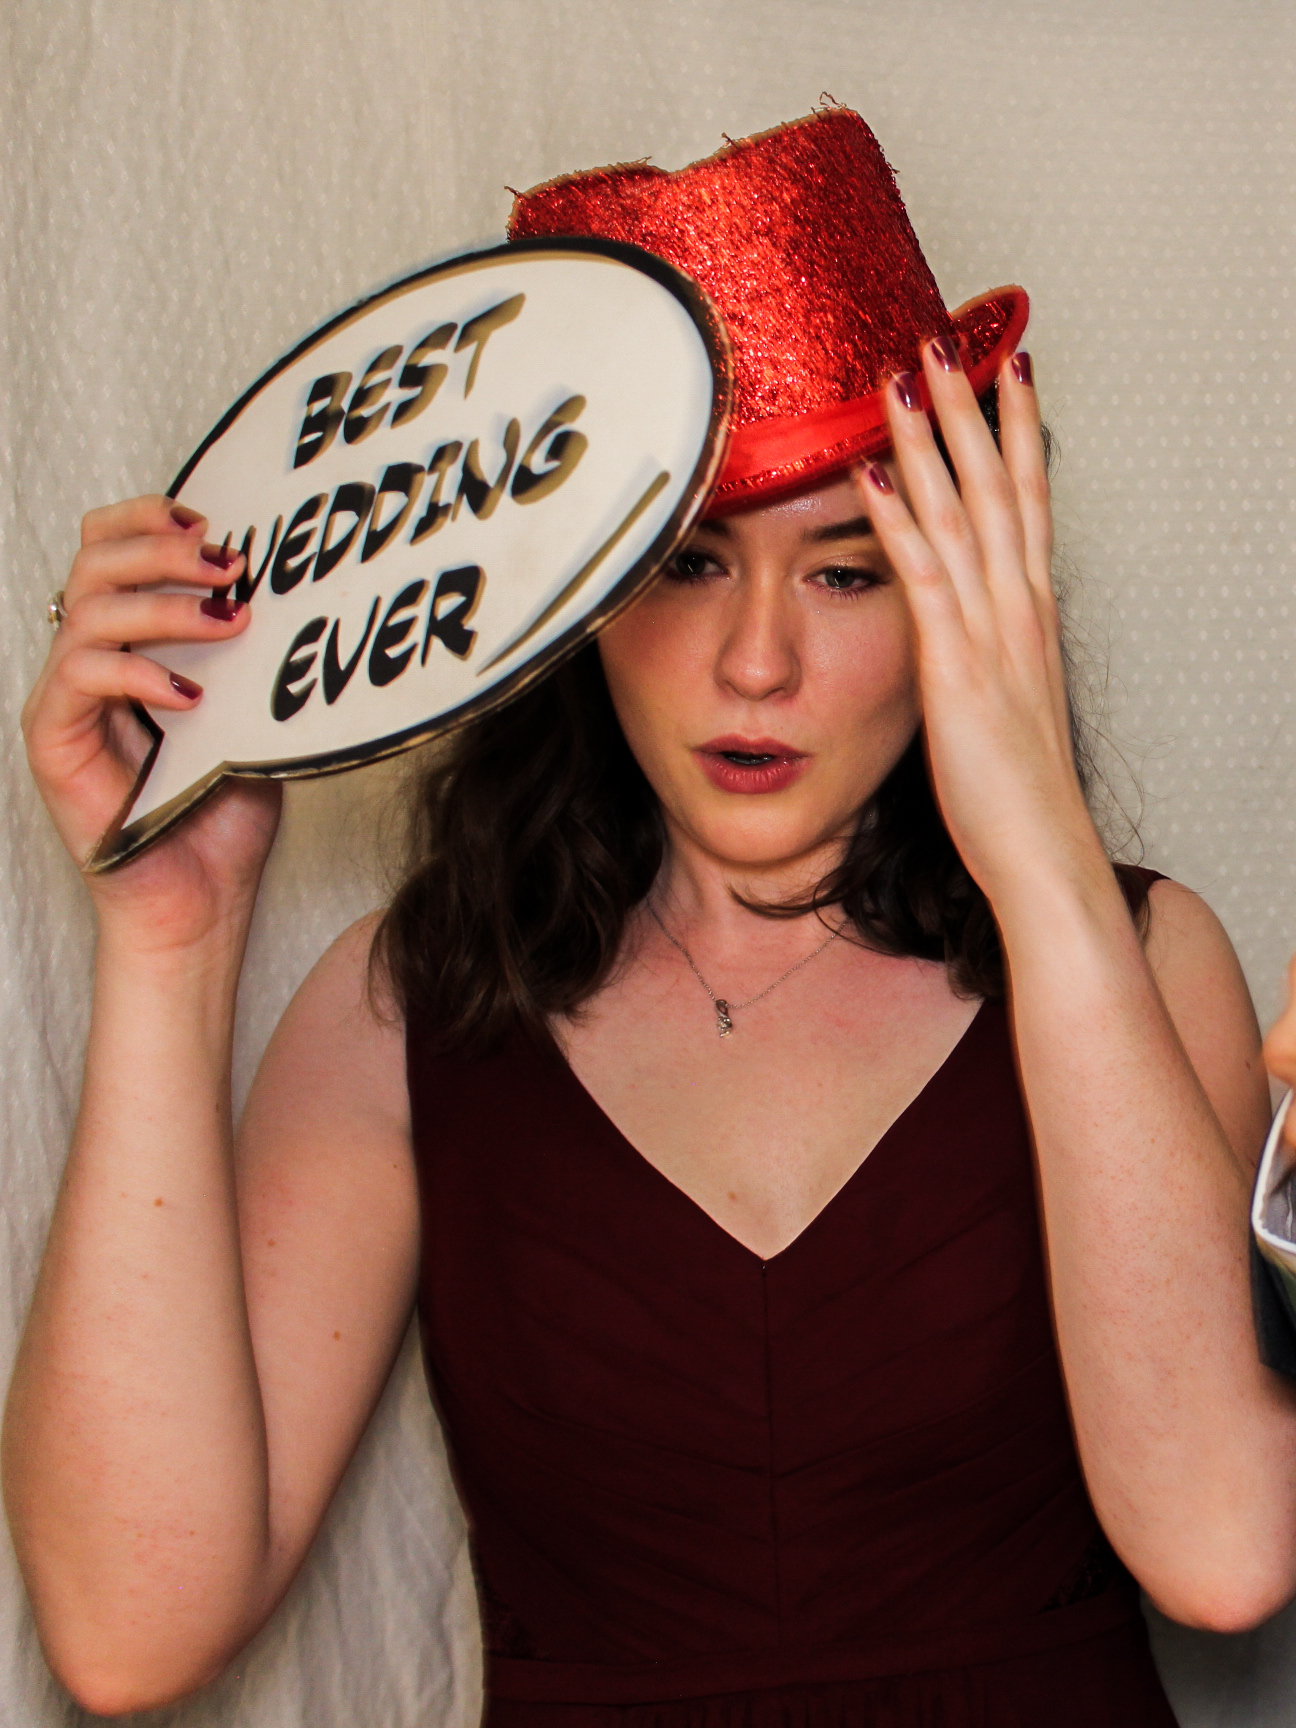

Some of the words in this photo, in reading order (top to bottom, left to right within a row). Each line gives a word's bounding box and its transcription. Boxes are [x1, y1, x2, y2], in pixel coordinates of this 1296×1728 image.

[293, 292, 526, 469] BEST
[211, 394, 588, 604] WEDDING
[270, 565, 487, 722] EVER
